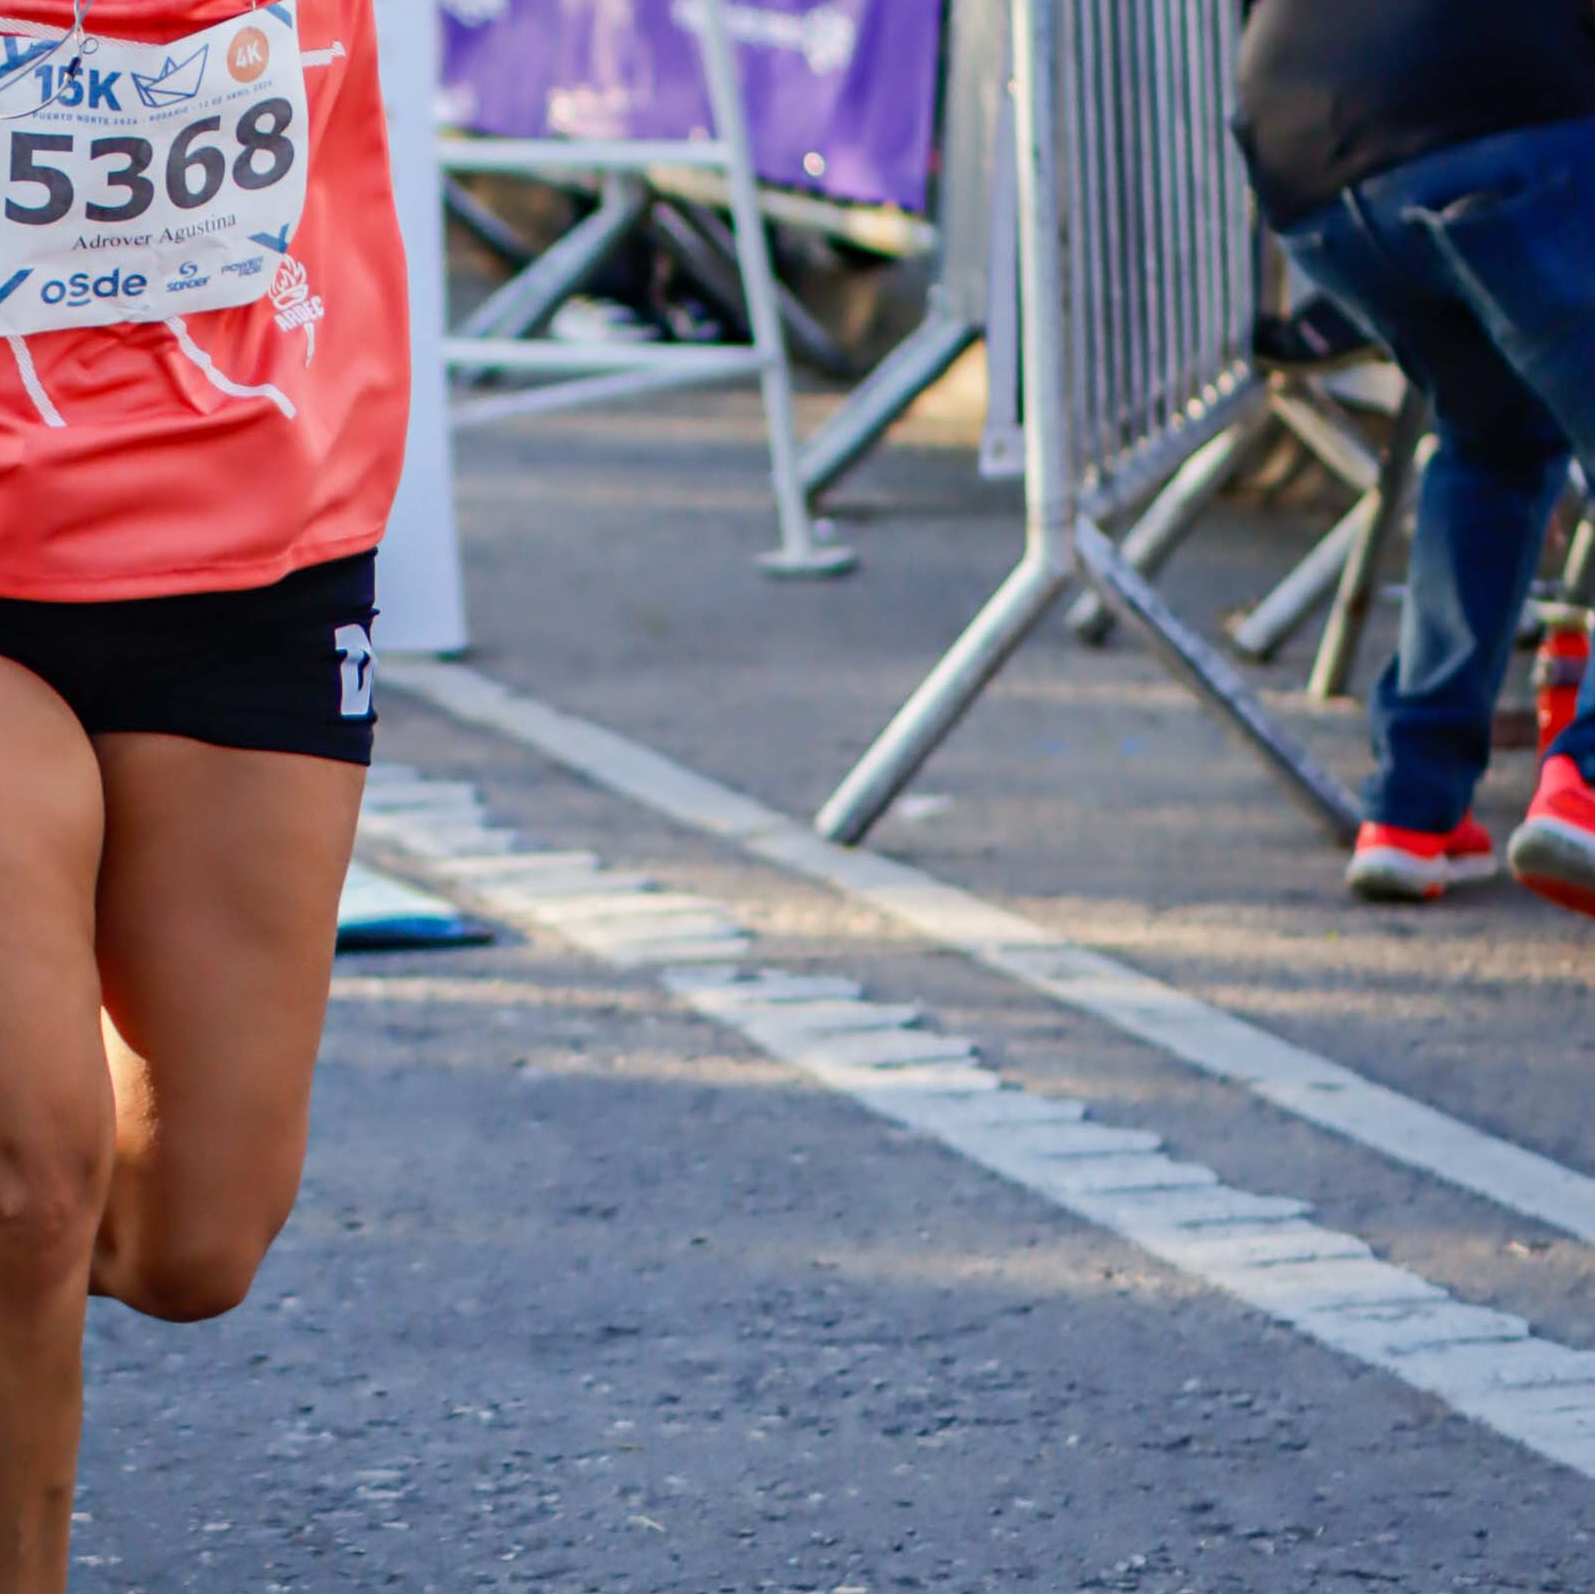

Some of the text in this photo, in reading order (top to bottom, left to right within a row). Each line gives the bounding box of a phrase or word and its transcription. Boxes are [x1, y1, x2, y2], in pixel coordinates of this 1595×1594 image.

[235, 41, 263, 69] 4K
[34, 64, 122, 112] 15K
[76, 115, 109, 125] NORTE
[5, 97, 294, 225] 5368
[71, 211, 237, 251] Adrover Agustina
[40, 265, 147, 306] osde
